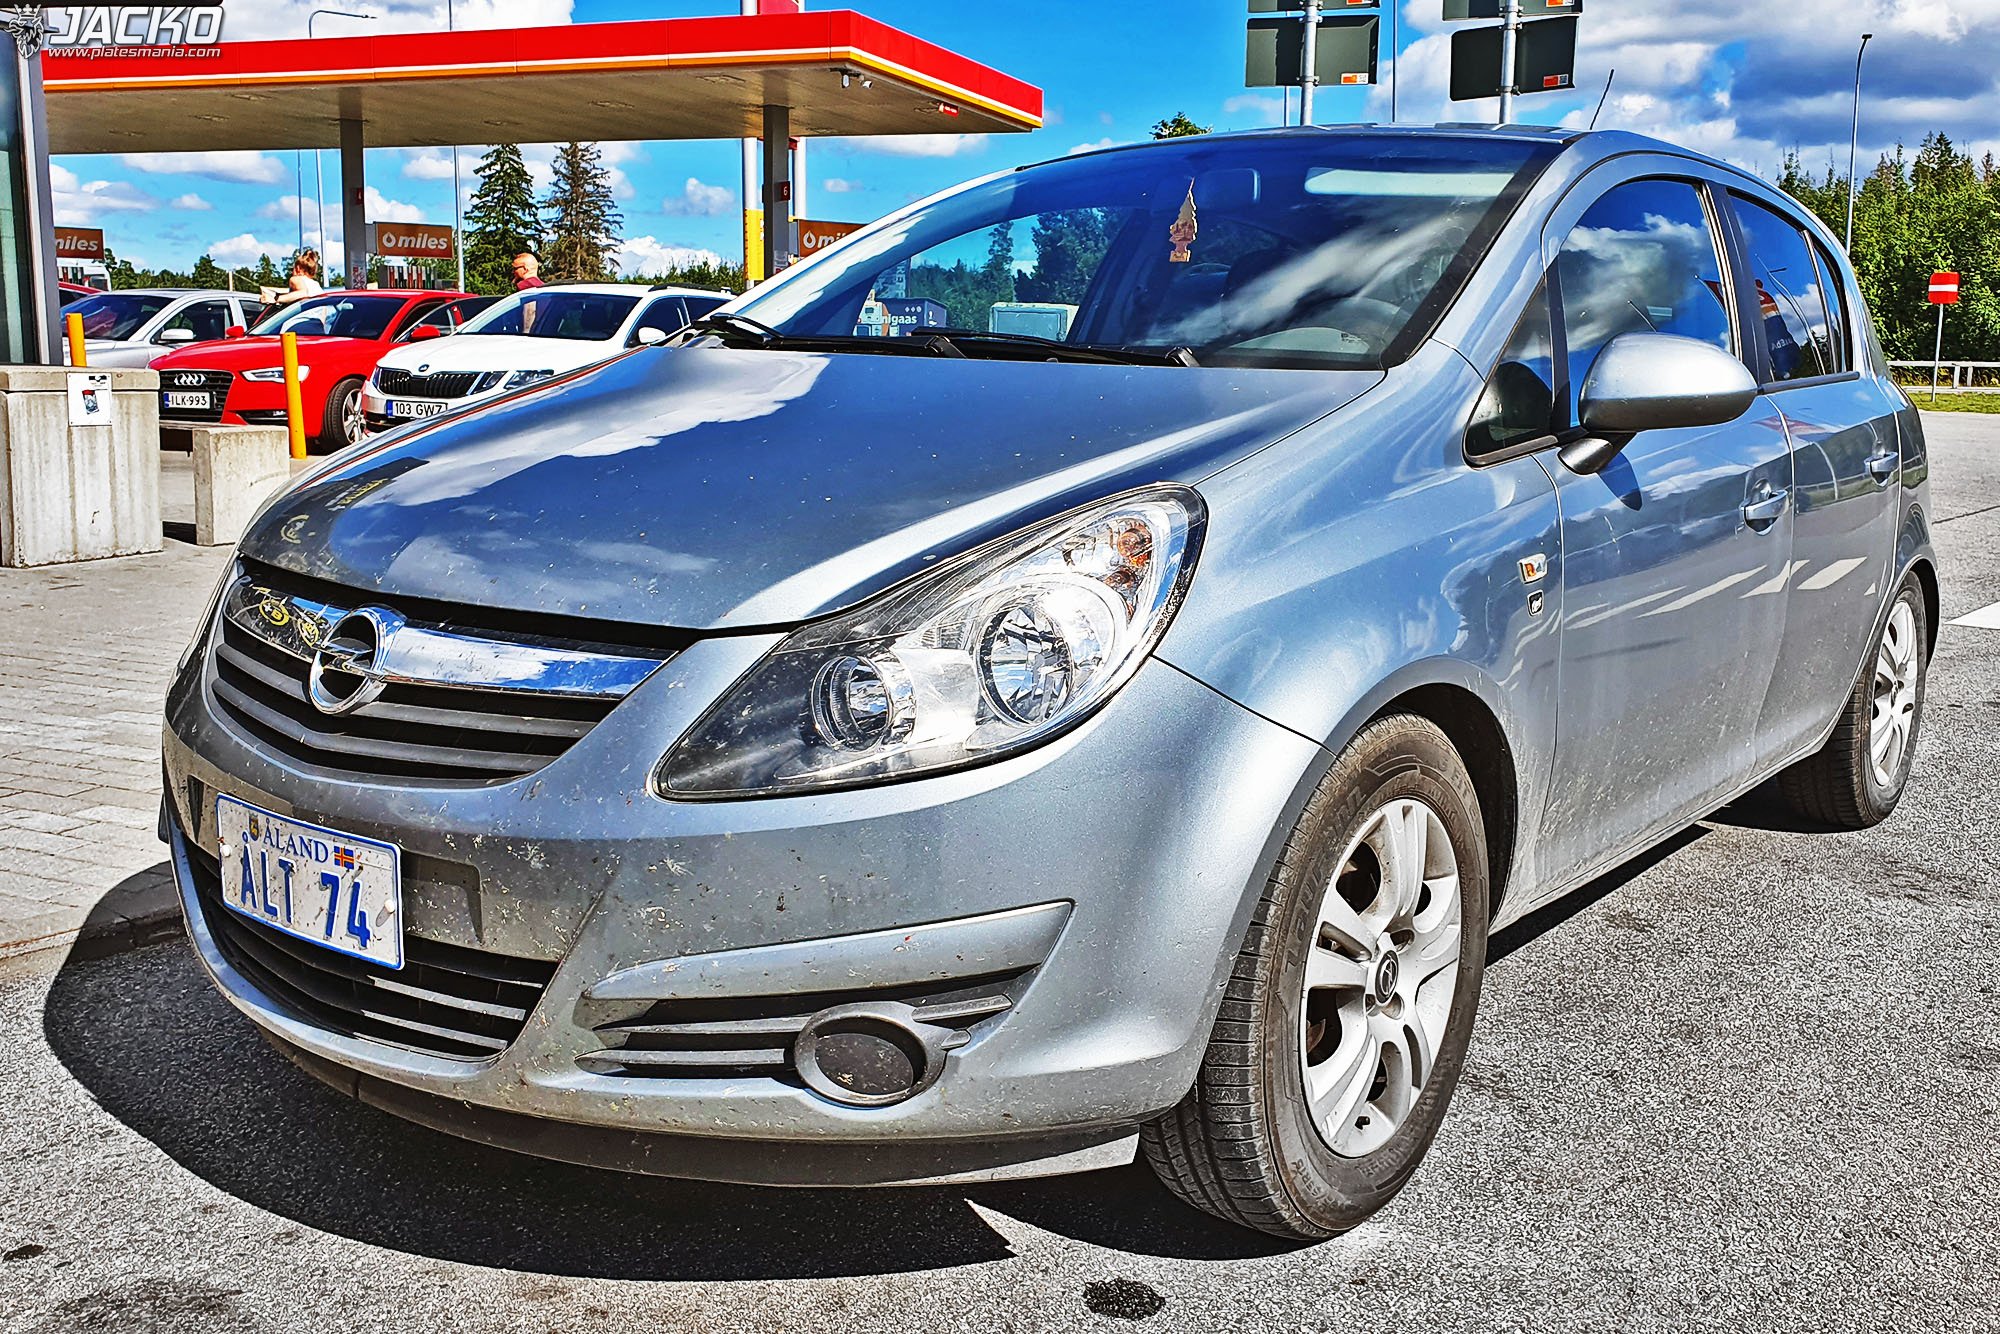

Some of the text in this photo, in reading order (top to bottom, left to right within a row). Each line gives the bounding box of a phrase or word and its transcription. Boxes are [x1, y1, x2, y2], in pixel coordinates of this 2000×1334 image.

[783, 186, 788, 196] 6
[397, 233, 448, 250] miles
[395, 403, 412, 415] 103
[263, 817, 329, 863] ÅLAND
[240, 831, 372, 949] ÅLT 74
